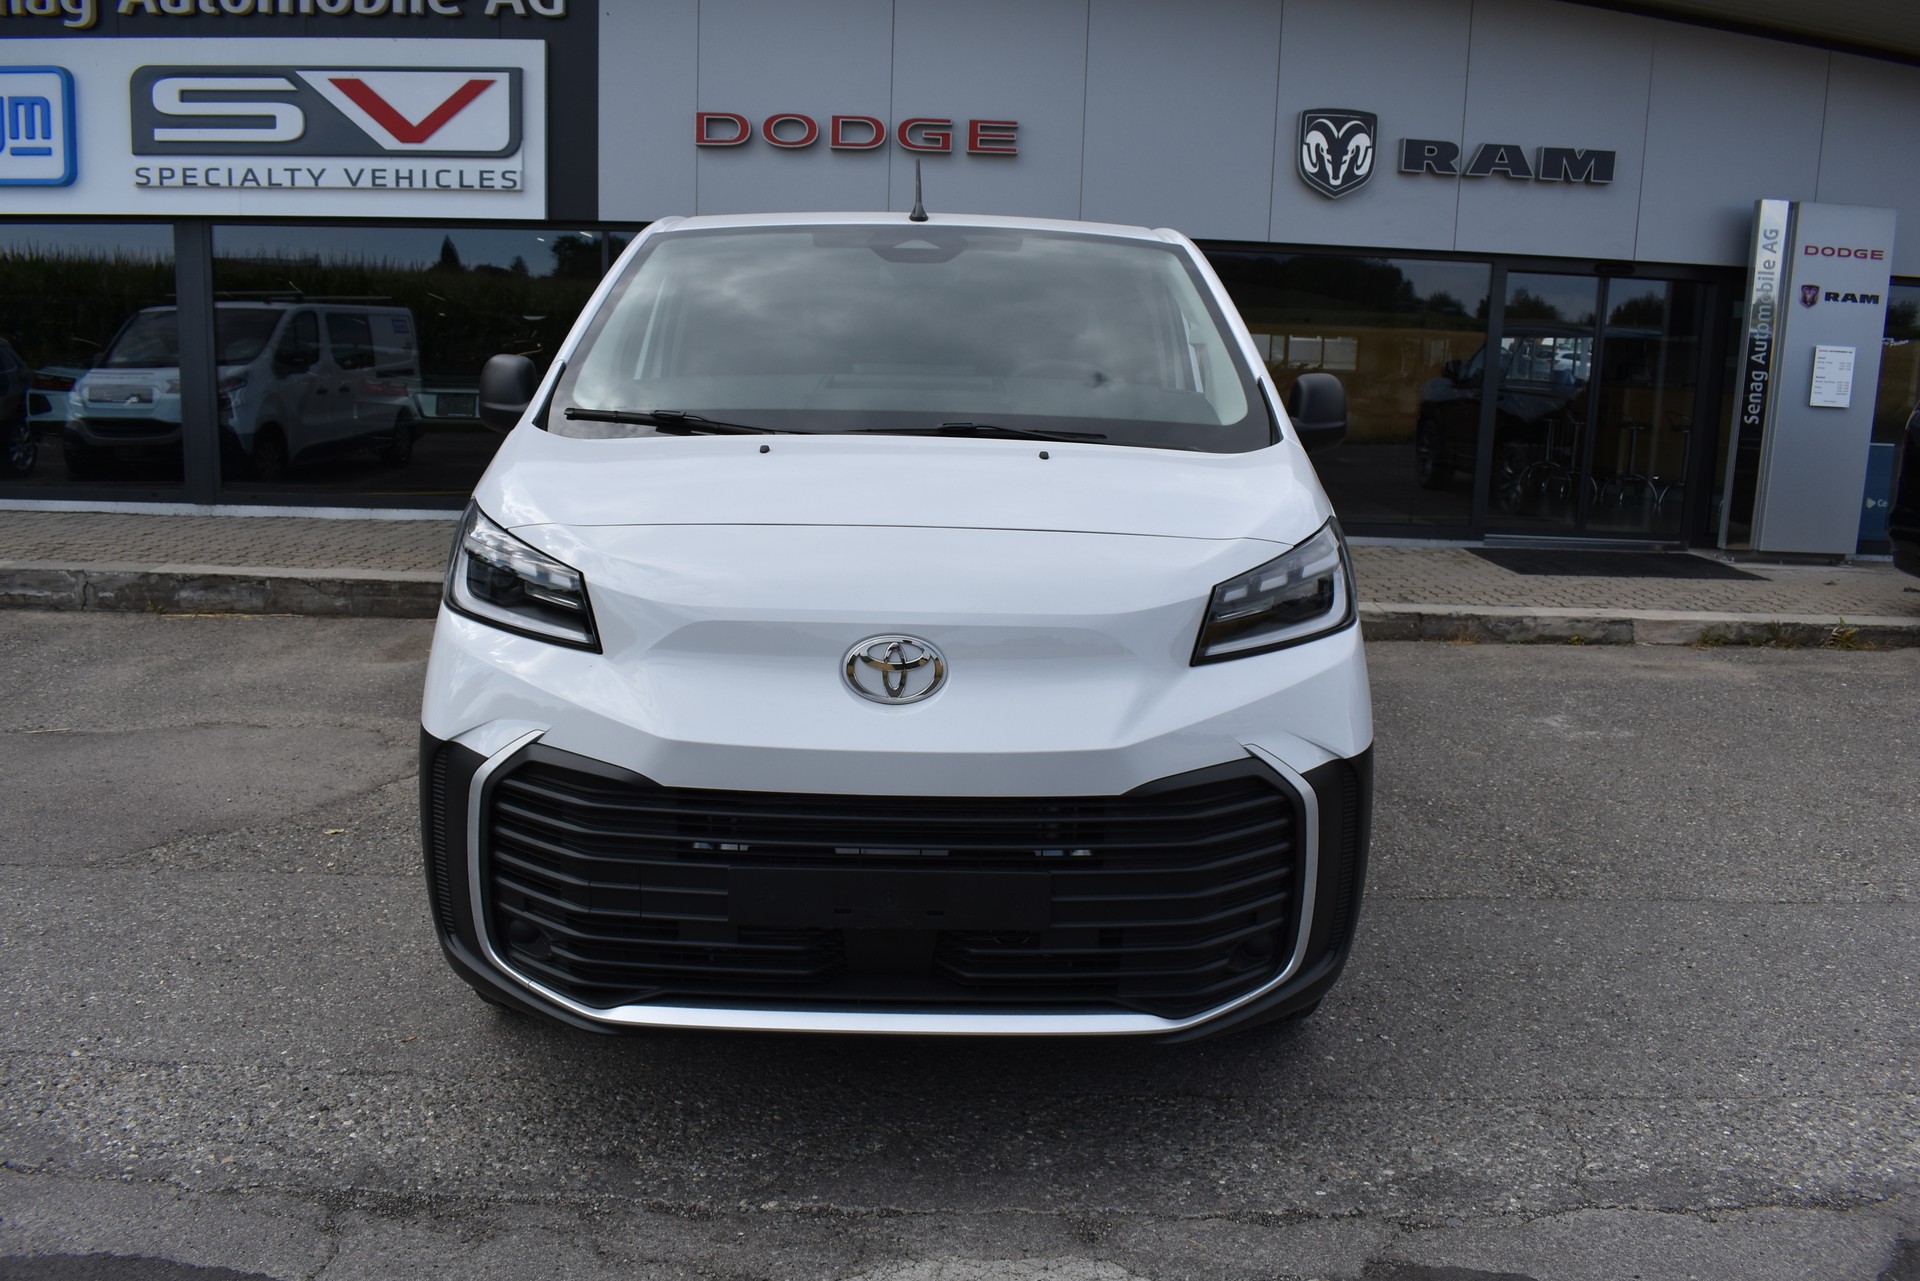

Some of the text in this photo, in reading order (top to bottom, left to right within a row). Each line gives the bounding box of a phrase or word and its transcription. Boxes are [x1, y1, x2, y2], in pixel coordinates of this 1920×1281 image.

[152, 77, 498, 143] SV
[695, 112, 1018, 155] DODGE
[135, 167, 518, 190] SPECIALTY VEHICLES
[1399, 138, 1616, 184] RAM
[1804, 245, 1884, 260] DODGE
[1824, 291, 1880, 305] RAM
[1743, 228, 1779, 425] Senag Automobile AG
